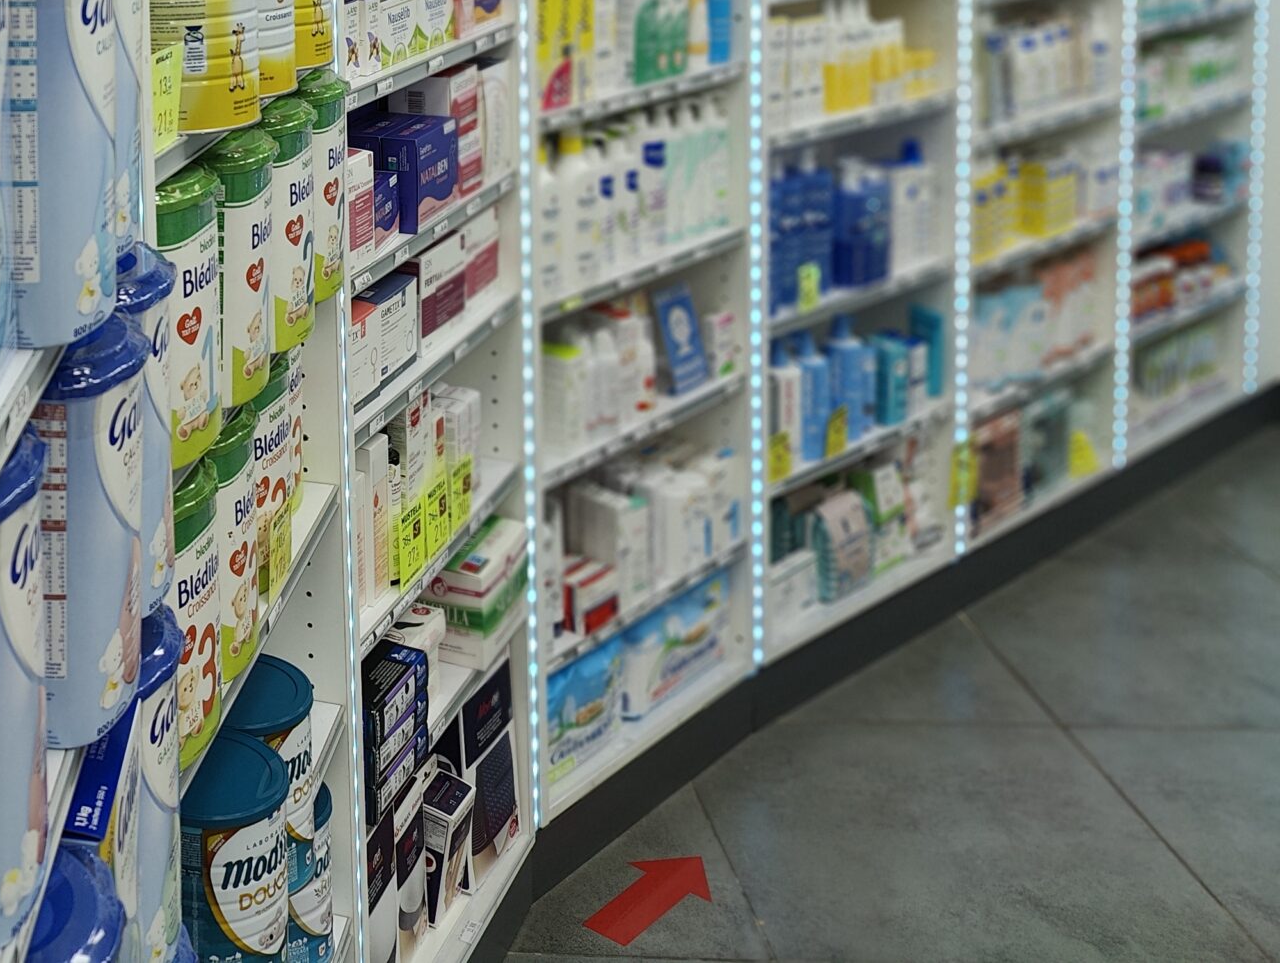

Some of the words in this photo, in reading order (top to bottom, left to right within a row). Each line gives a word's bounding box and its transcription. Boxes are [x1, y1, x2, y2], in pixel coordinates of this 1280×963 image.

[387, 6, 411, 26] Nausélib
[419, 157, 449, 187] NATALBEN
[380, 299, 401, 320] GAMETIX
[400, 503, 422, 526] MUSTELA
[199, 621, 217, 720] 3
